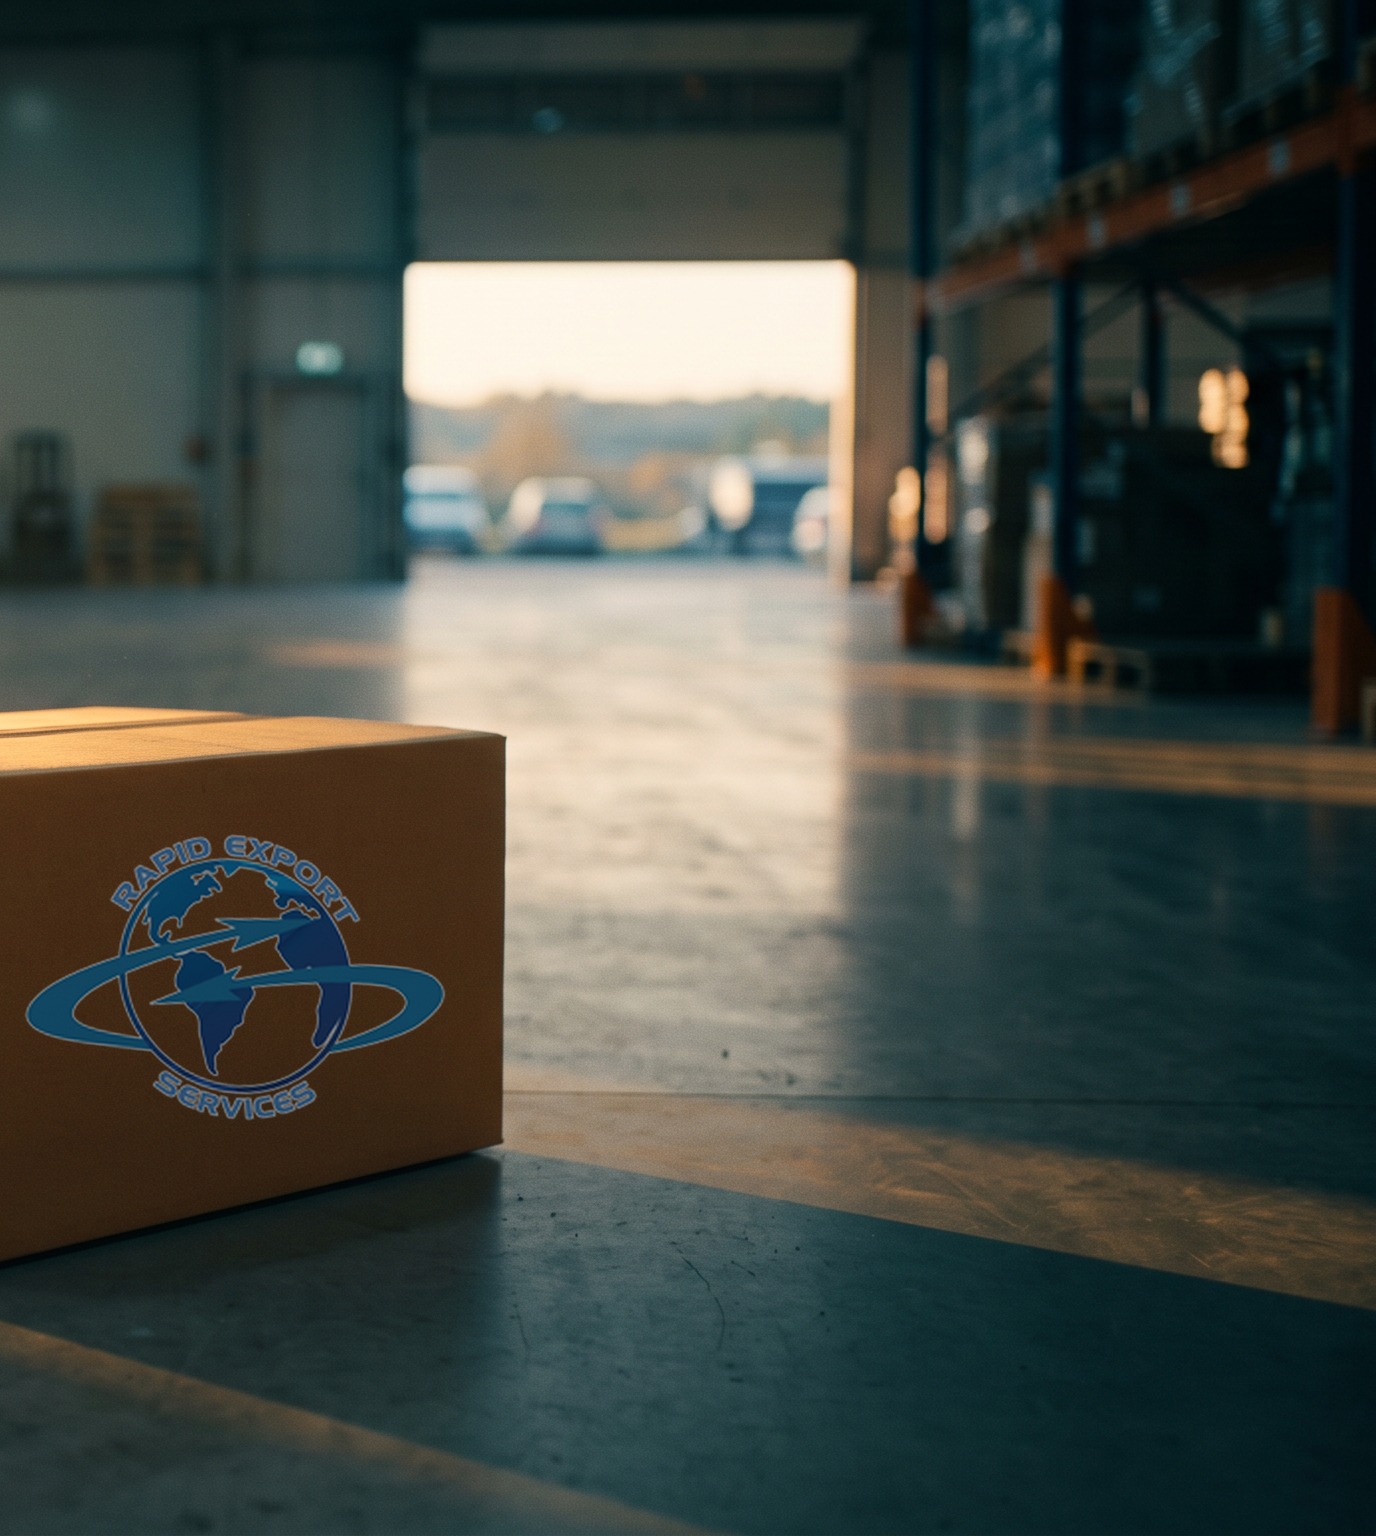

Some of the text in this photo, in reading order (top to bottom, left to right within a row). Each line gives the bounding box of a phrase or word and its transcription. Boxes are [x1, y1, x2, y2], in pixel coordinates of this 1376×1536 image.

[111, 835, 360, 923] RAPID EXPORT
[153, 1071, 316, 1119] SERVICES
